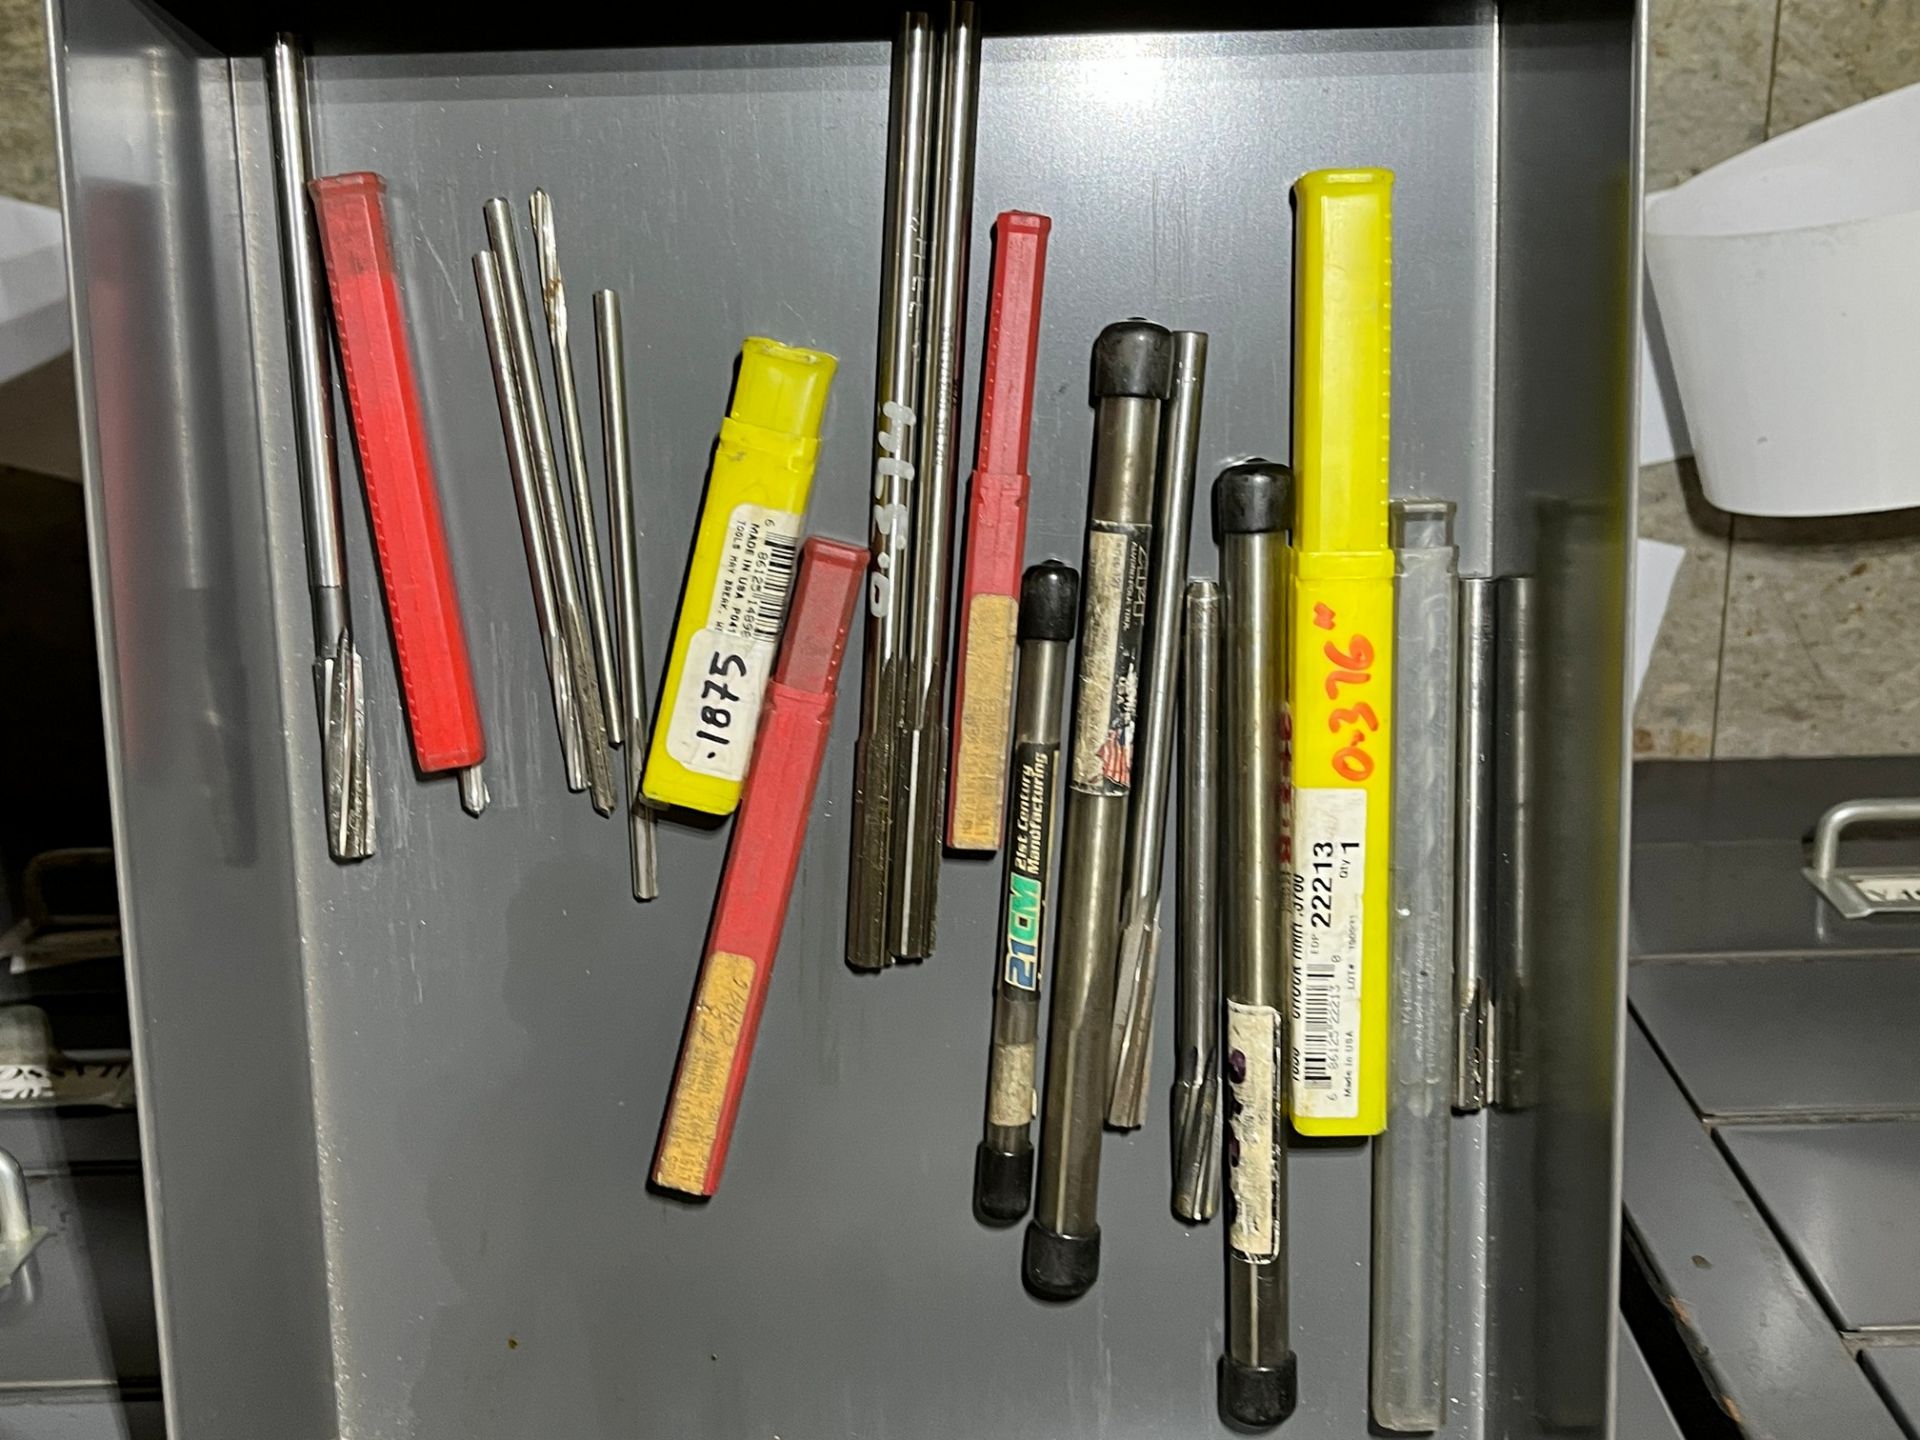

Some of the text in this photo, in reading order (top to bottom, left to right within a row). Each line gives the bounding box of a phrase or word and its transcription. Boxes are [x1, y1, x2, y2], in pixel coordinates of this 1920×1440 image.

[732, 520, 746, 550] TOOLS
[745, 523, 760, 556] MADE
[728, 555, 738, 574] MAY
[742, 559, 752, 572] IN
[750, 552, 769, 592] 86125
[735, 577, 748, 599] USA
[696, 651, 747, 759] .1875
[1015, 765, 1034, 871] 21st Century
[1027, 752, 1048, 875] Manufacturing
[1339, 842, 1360, 878] Qty 1
[1311, 842, 1333, 928] 22213
[1005, 872, 1041, 991] 21CM
[1345, 1031, 1354, 1051] USA
[1344, 1072, 1353, 1098] Made
